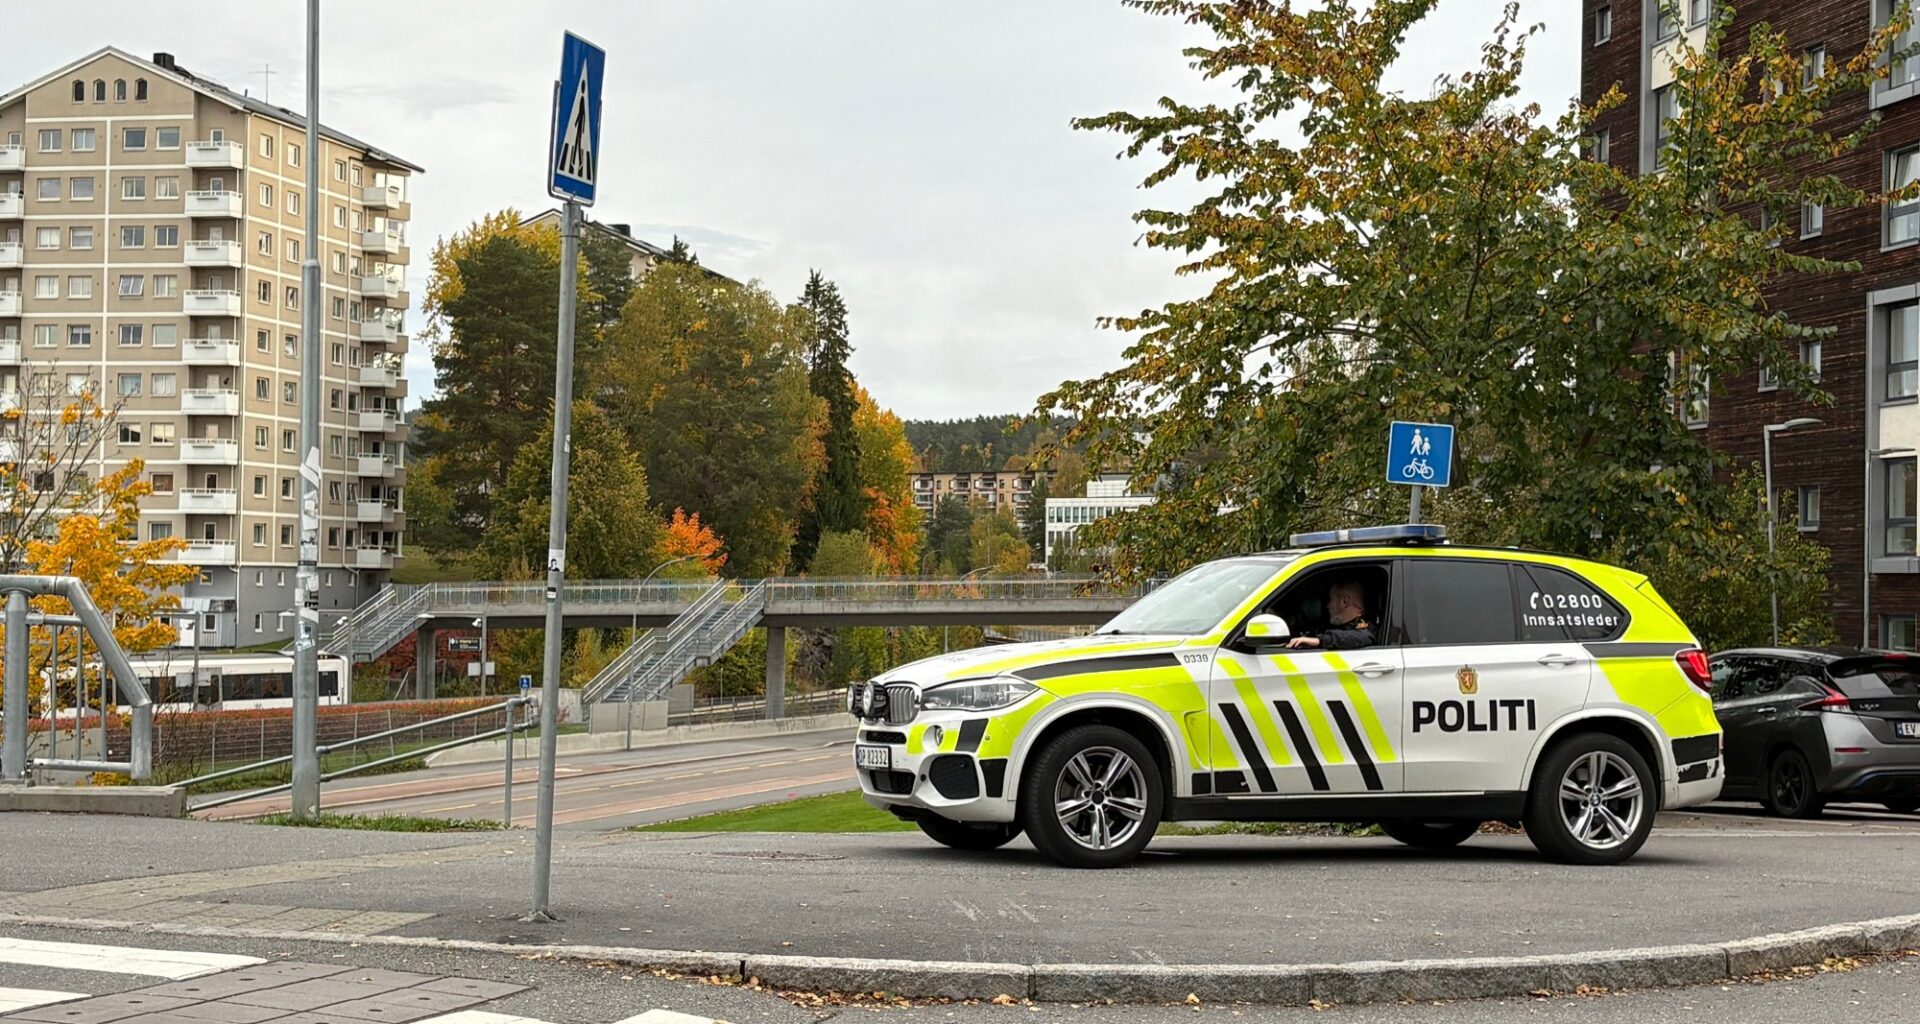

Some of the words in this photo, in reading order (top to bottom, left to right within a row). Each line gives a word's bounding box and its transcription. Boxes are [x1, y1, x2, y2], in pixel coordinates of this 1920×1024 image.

[1543, 594, 1602, 608] 02800
[1523, 613, 1618, 626] Innsatsleder
[1412, 699, 1536, 733] POLITI
